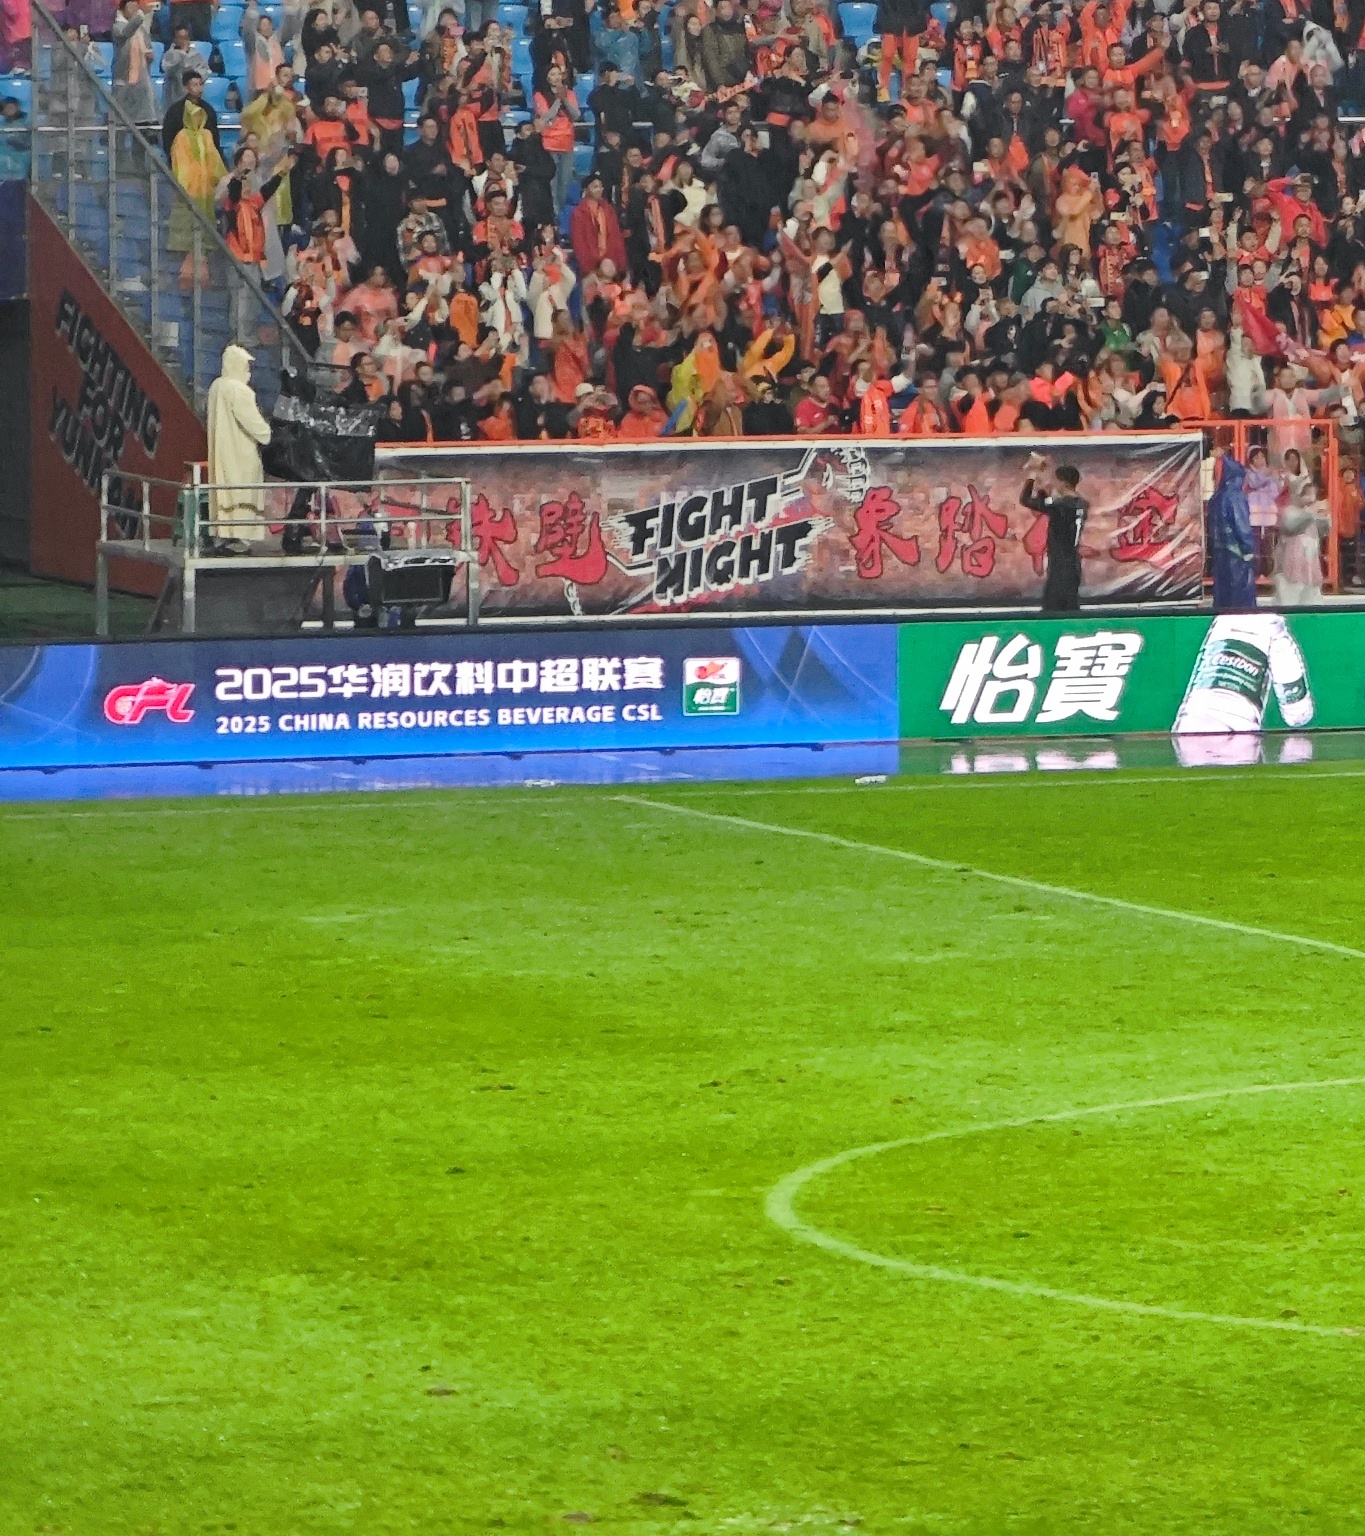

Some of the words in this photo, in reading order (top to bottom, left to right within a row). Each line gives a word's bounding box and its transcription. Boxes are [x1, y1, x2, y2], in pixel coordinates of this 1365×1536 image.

[625, 475, 783, 558] FIGHT
[654, 520, 816, 605] NIGHT
[214, 656, 666, 702] 2025华润饮料中超联赛
[938, 630, 1145, 725] 怡寶
[215, 715, 271, 735] 2025
[280, 713, 350, 733] CHINA
[358, 710, 490, 731] RESOURCES
[498, 706, 615, 727] BEVERAGE
[622, 704, 664, 723] CSL
